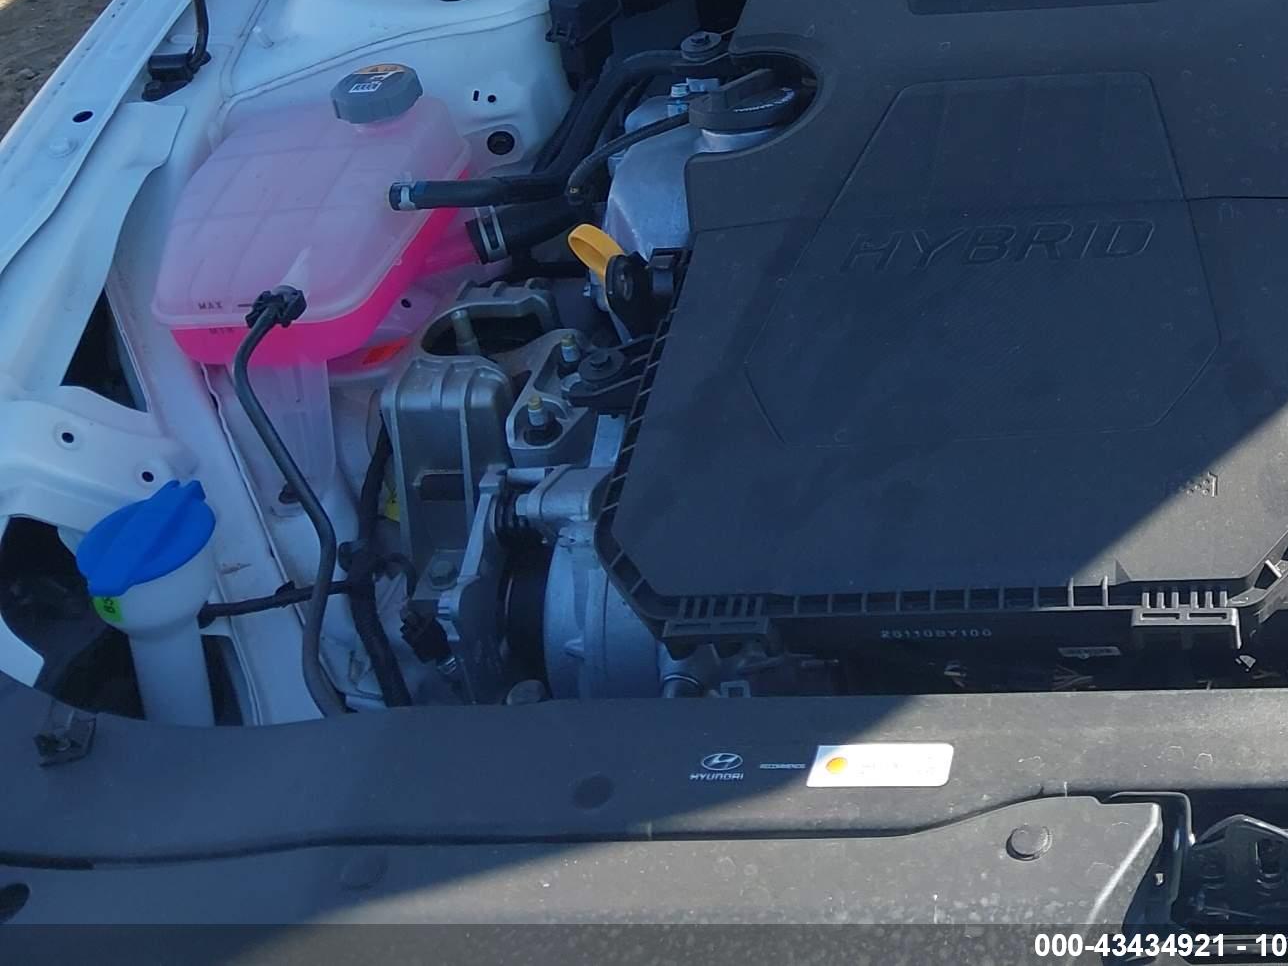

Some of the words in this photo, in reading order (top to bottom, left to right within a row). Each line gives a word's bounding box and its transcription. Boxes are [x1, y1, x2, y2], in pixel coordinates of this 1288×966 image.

[841, 218, 1156, 273] HYBRID
[198, 301, 223, 310] MAX
[689, 772, 744, 781] HYUNDAI
